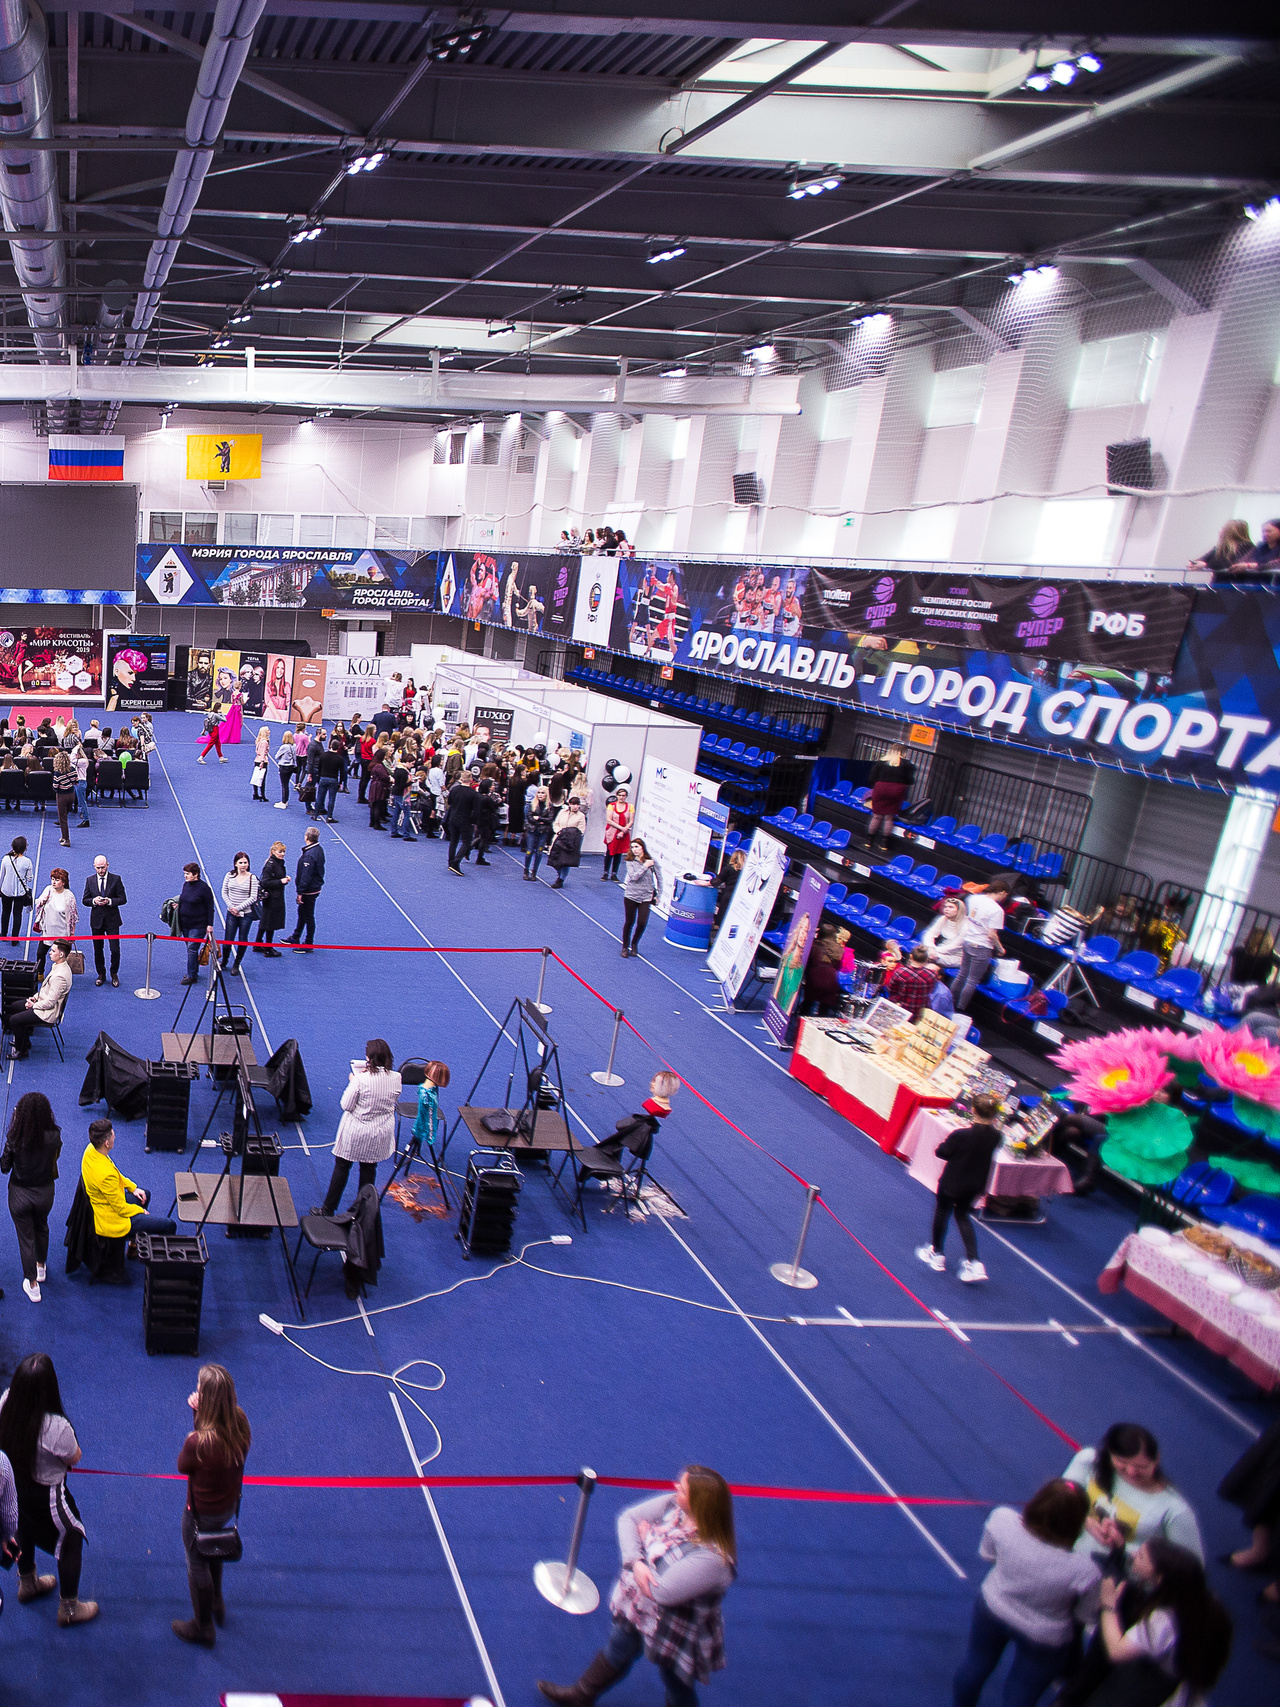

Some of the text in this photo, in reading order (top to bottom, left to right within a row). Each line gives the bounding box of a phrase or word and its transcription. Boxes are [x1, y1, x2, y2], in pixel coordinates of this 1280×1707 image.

[191, 548, 353, 562] МЭРИЯ ГОРОДА ЯРОСЛАВЛЯ
[353, 588, 414, 599] ЯРОСЛАВЛЬ
[823, 589, 851, 601] molten
[351, 597, 431, 608] ГОРОД СПОРТА!
[922, 596, 993, 610] ЧЕМПИОНАТ РОССИИ
[865, 602, 898, 621] СУПЕР
[911, 606, 999, 622] СРЕДИ МУЖСКИХ КОМАНД
[869, 618, 887, 629] ЛИГА
[924, 618, 982, 631] СЕЗОН 2018-2019
[1016, 617, 1065, 638] СУПЕР
[1088, 610, 1147, 637] РФБ
[29, 639, 94, 648] «МИР КРАСОТЫ»
[1024, 635, 1049, 648] ЛИГА
[347, 658, 382, 677] КОД
[687, 630, 856, 690] ЯРОСЛАВЛЬ
[881, 661, 1033, 735] ГОРОД
[476, 710, 511, 721] LUXIO
[656, 767, 668, 780] MC
[689, 781, 703, 795] MC
